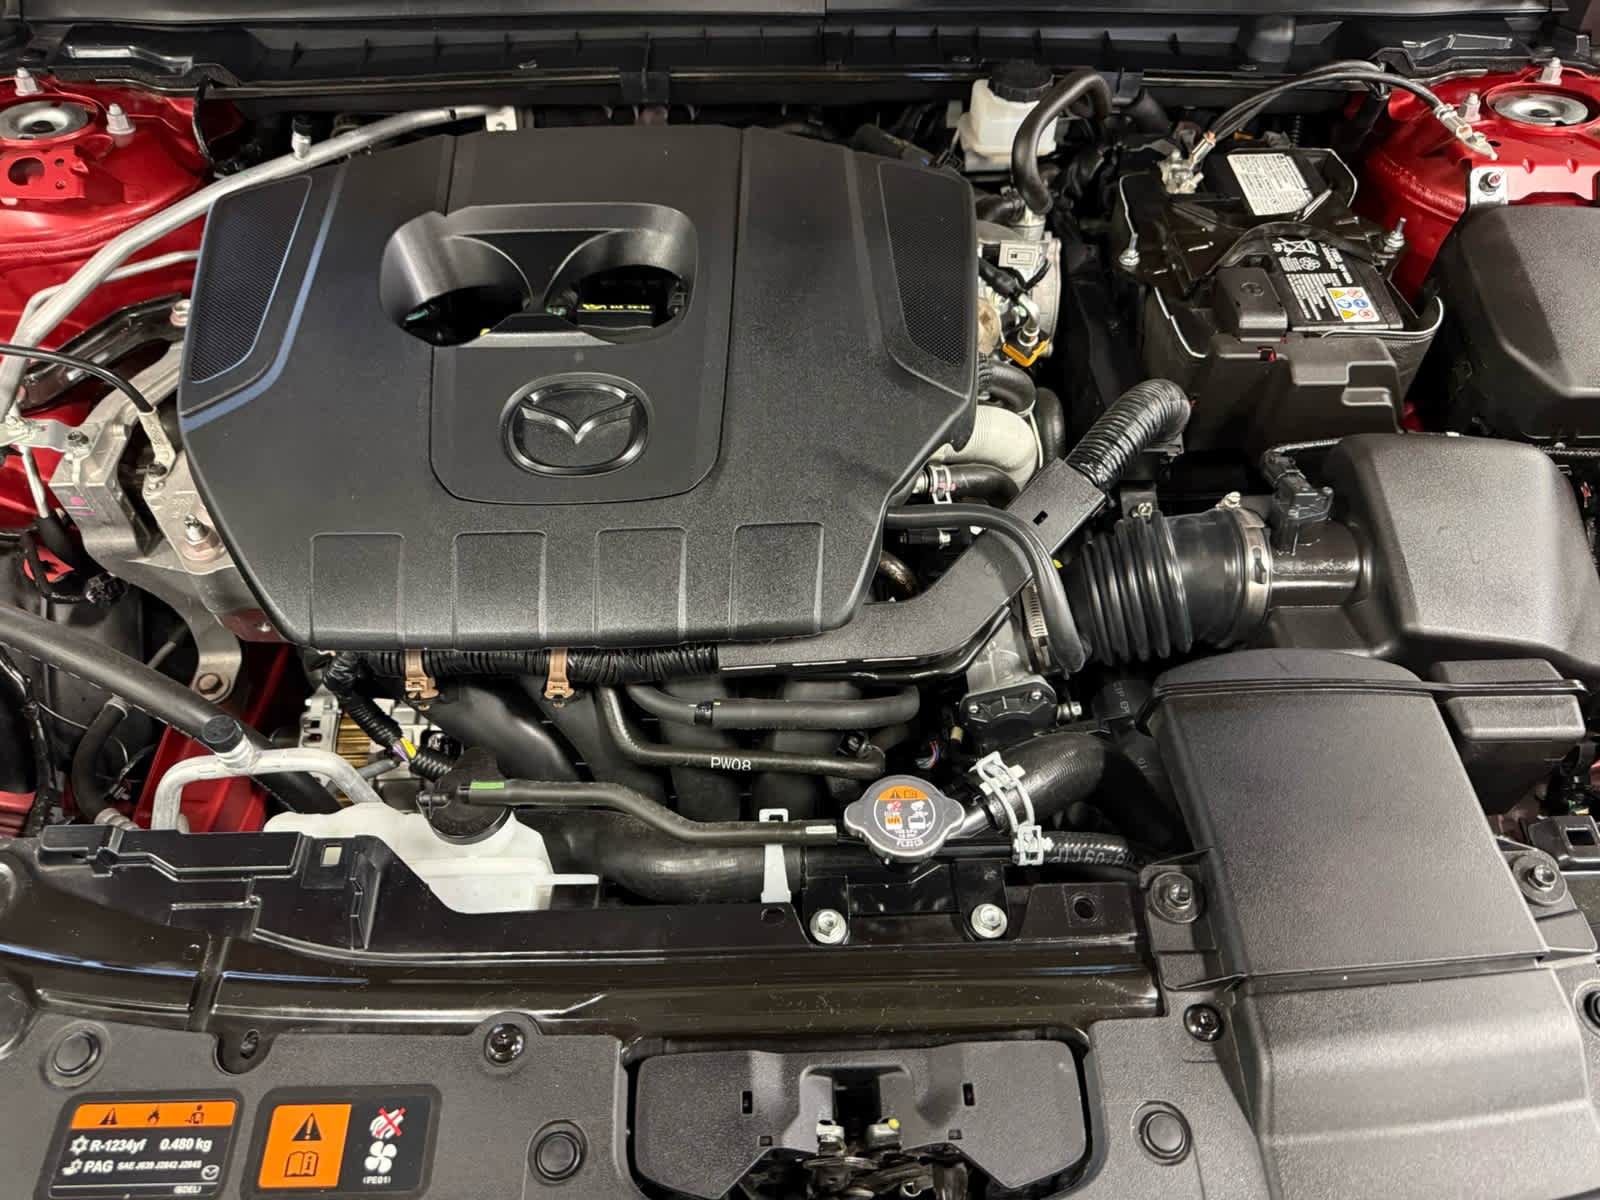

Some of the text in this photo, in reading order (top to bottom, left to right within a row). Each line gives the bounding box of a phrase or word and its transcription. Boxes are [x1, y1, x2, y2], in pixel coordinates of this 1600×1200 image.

[710, 756, 752, 771] PW08
[89, 1138, 213, 1154] R-1234yf 0.480 kg
[82, 1160, 114, 1174] PAG
[116, 1161, 136, 1171] SAE
